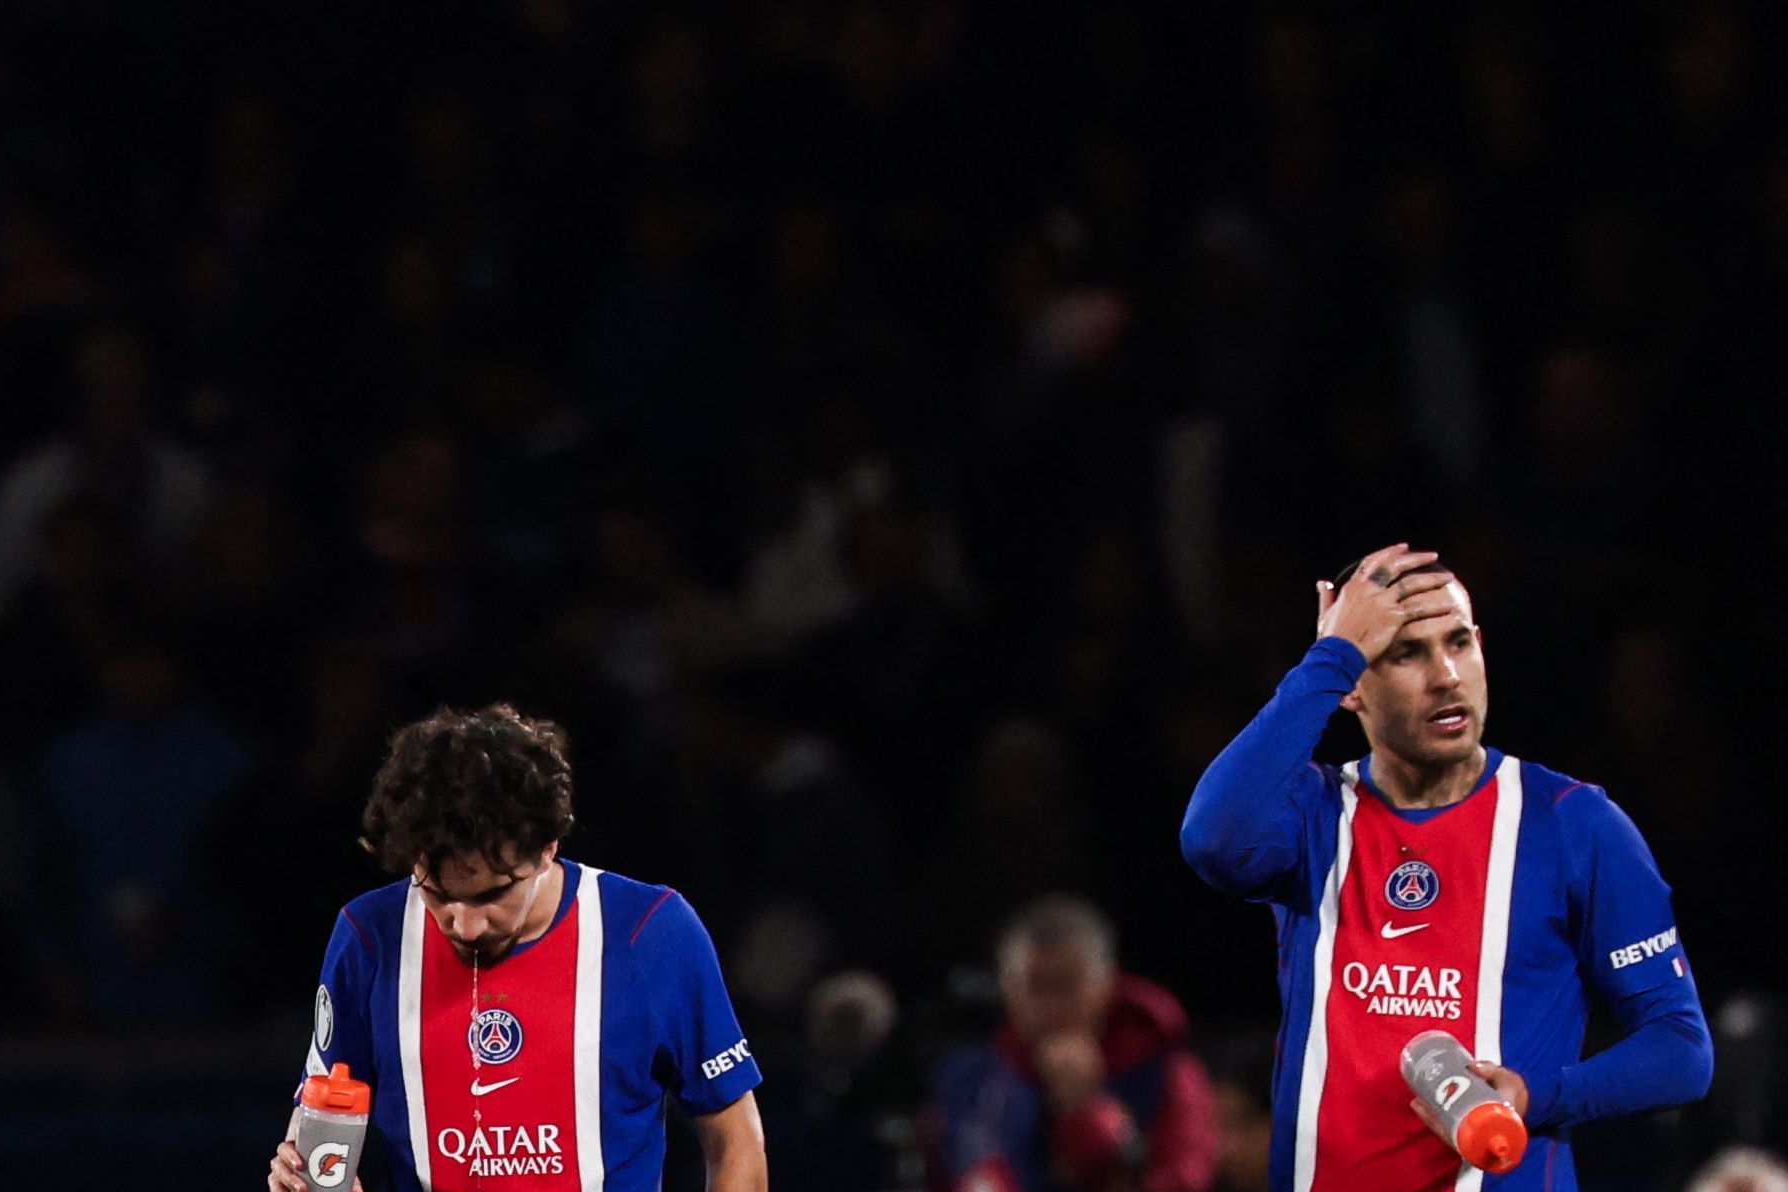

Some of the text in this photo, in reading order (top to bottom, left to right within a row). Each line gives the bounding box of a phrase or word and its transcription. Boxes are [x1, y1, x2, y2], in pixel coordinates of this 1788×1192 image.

[1342, 961, 1462, 999] QATAR
[478, 1012, 512, 1026] PARIS
[1366, 995, 1461, 1020] AIRWAYS
[438, 1124, 562, 1164] QATAR
[308, 1142, 350, 1188] G
[469, 1155, 564, 1176] AIRWAYS
